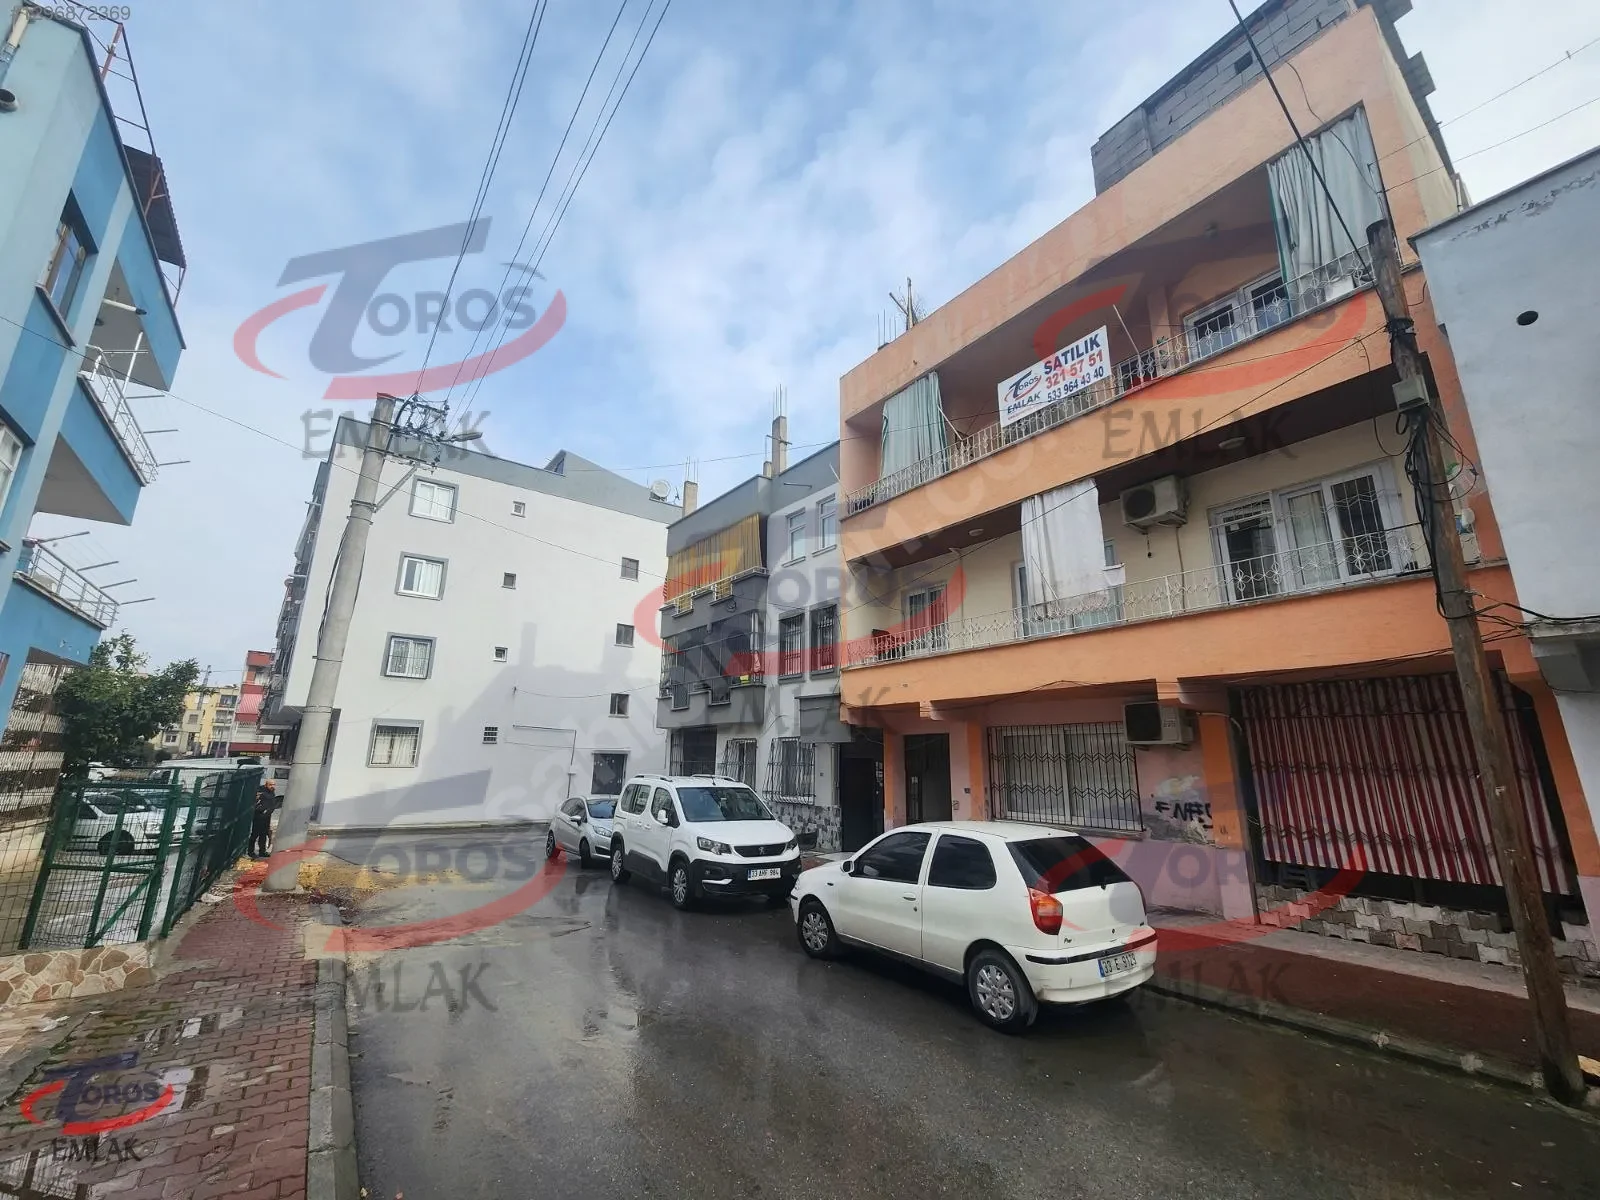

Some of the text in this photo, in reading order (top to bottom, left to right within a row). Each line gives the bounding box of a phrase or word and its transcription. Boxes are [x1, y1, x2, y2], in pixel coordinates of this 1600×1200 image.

[1044, 333, 1101, 375] SATILIK
[1045, 349, 1103, 390] 321 57 51
[1008, 369, 1039, 399] TOROS
[1047, 366, 1104, 403] 533 964 43 40
[1007, 391, 1042, 414] EMLAK
[1102, 960, 1113, 974] 33
[1114, 958, 1121, 971] E
